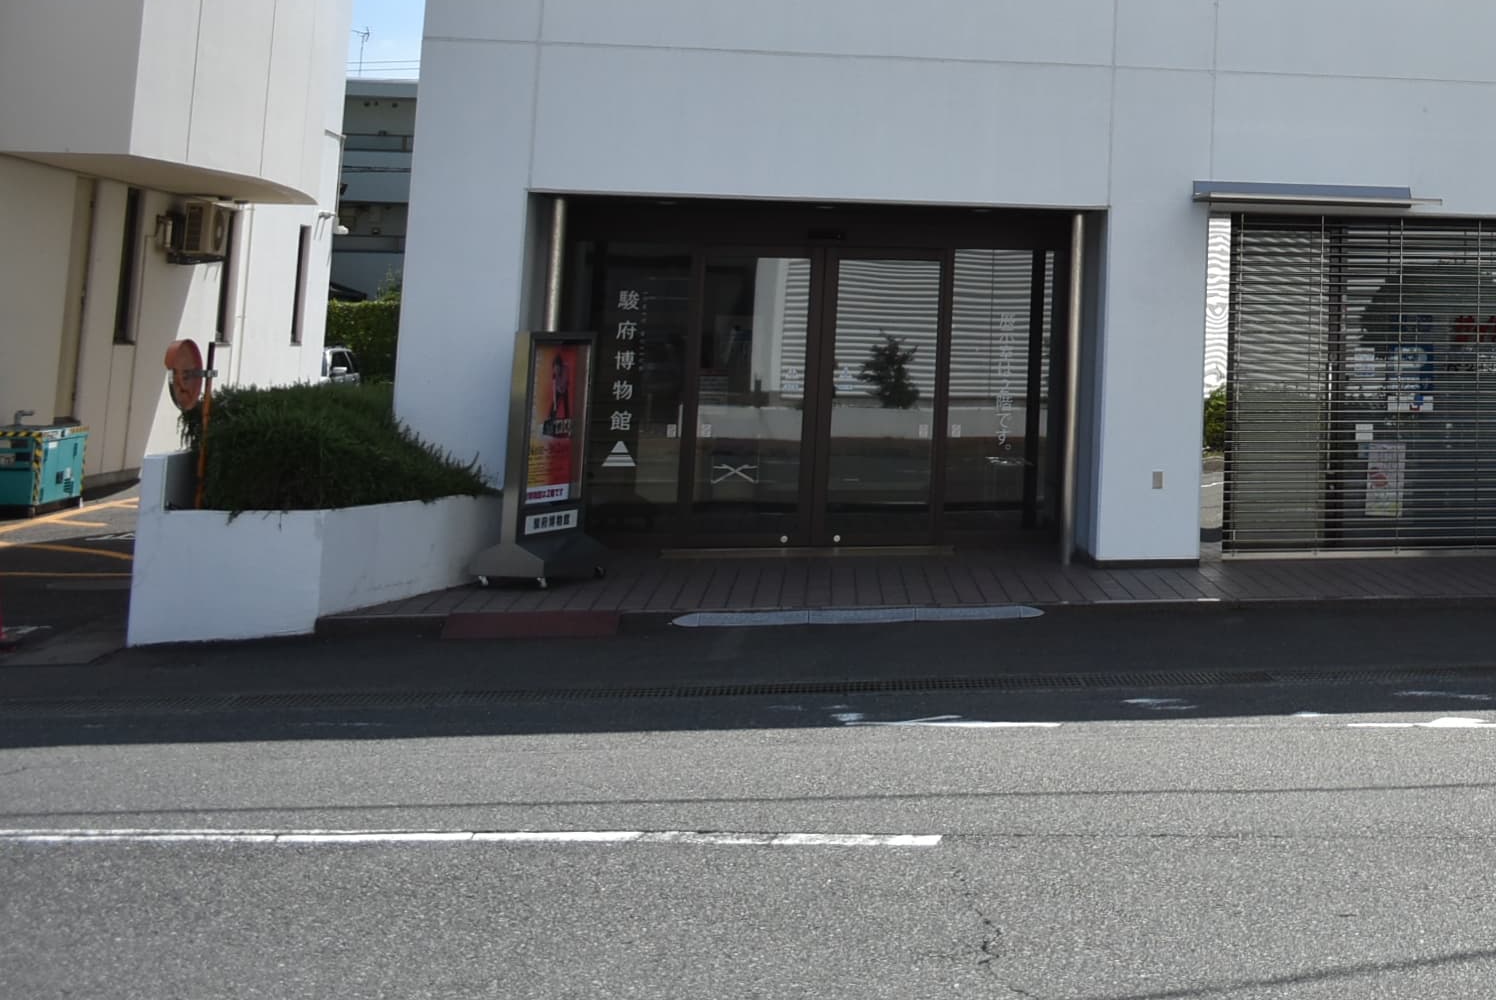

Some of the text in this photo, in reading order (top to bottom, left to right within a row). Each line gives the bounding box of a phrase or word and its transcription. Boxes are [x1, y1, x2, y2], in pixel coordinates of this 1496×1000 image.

[610, 289, 640, 432] 駿府博物館
